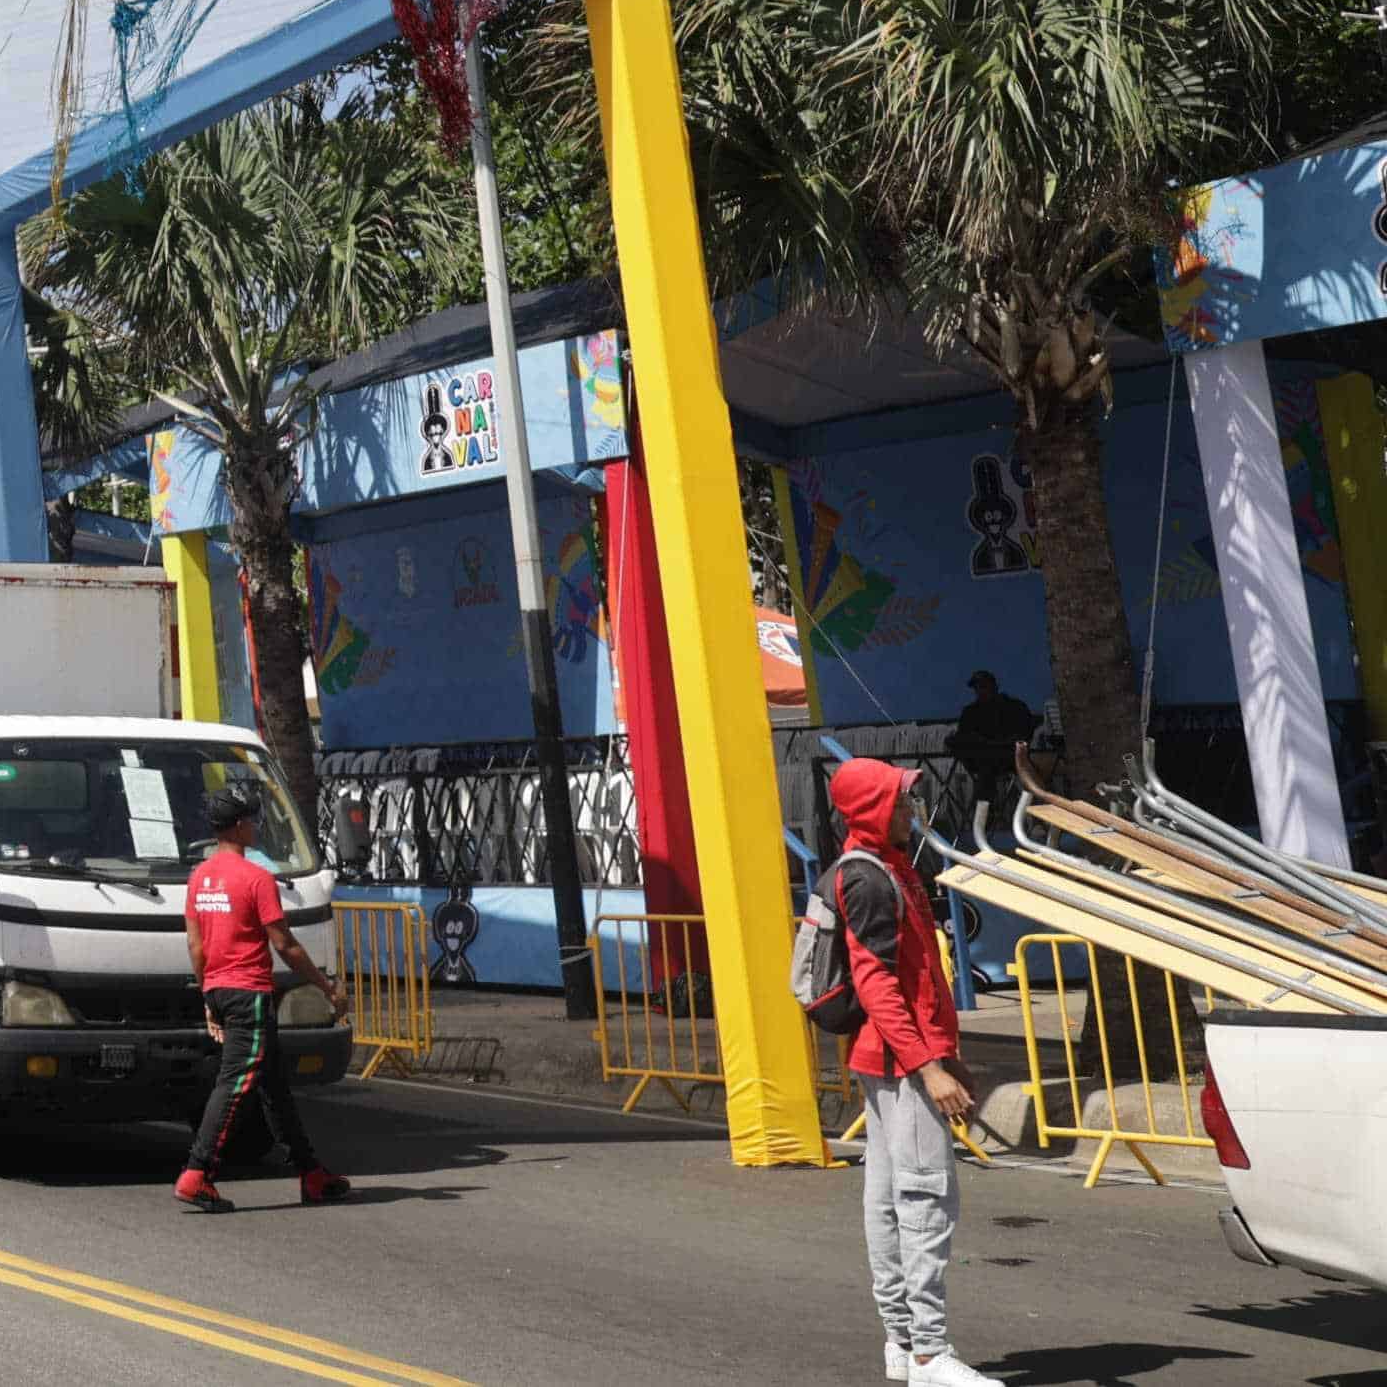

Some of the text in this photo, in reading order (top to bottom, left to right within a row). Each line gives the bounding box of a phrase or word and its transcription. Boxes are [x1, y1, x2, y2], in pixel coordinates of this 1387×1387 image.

[449, 372, 493, 407] CAR
[455, 404, 489, 436] NA
[451, 434, 498, 467] VAL
